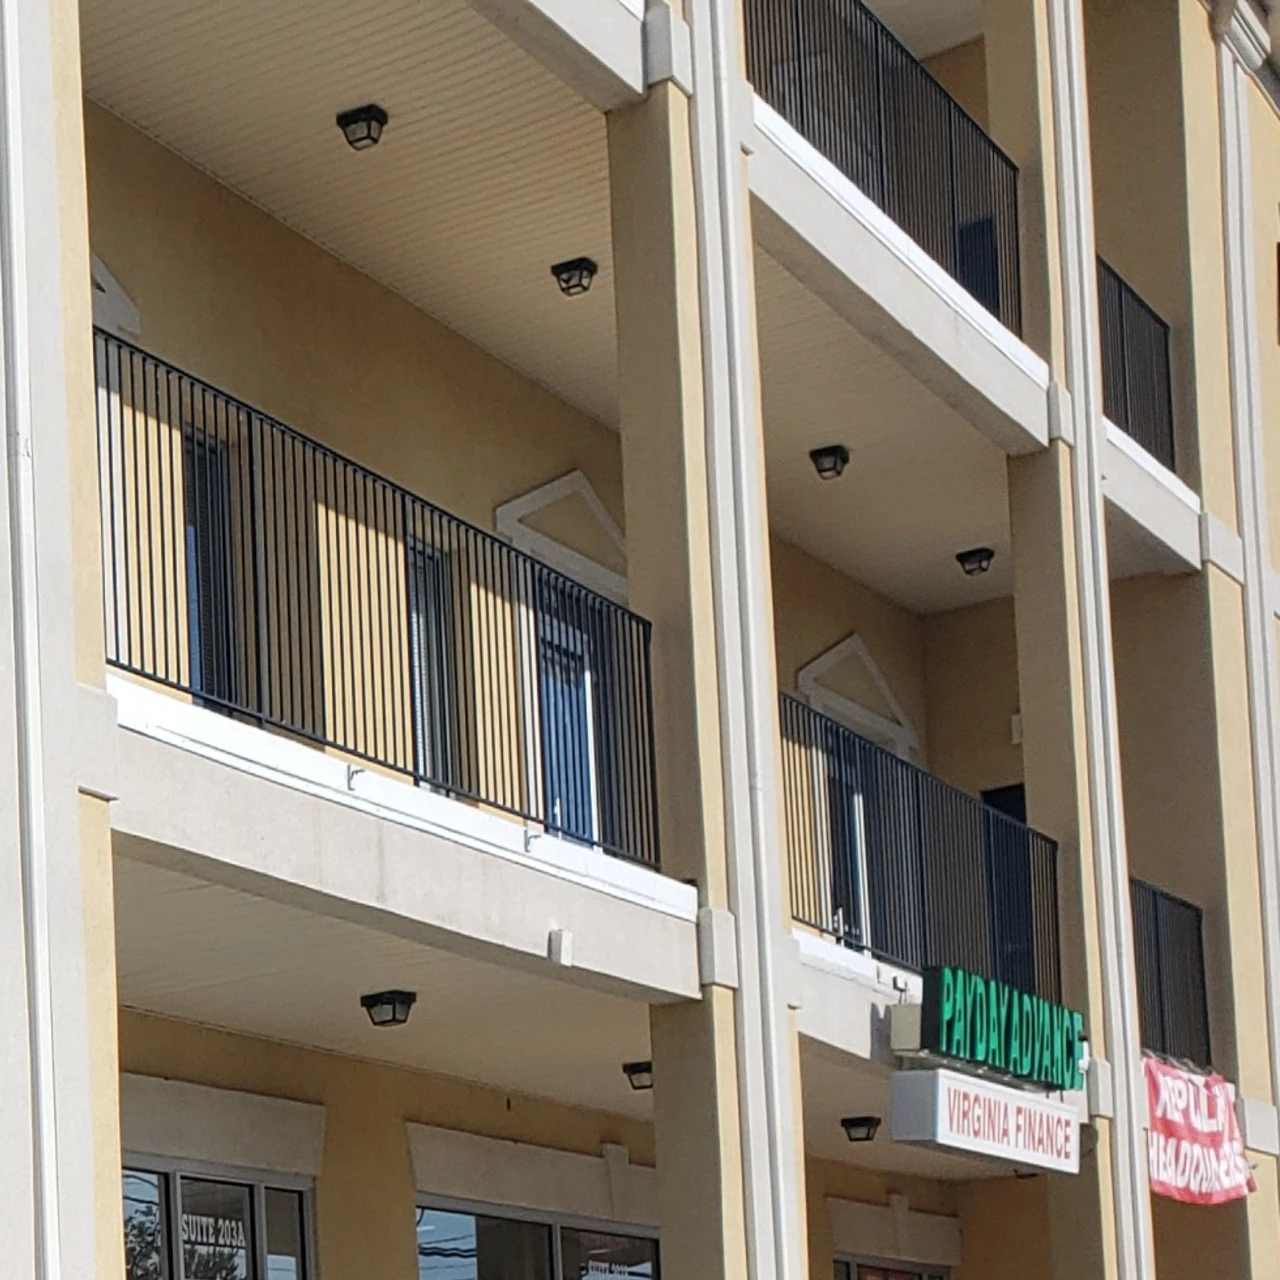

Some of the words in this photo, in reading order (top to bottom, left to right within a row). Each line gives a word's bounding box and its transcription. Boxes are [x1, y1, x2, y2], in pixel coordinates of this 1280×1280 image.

[942, 967, 1009, 1068] PAYDAY
[1009, 989, 1084, 1091] ADVANCE
[947, 1088, 1009, 1147] VIRGINIA
[1015, 1105, 1071, 1160] FINANCE
[182, 1213, 215, 1243] SUITE
[217, 1217, 246, 1247] 203A
